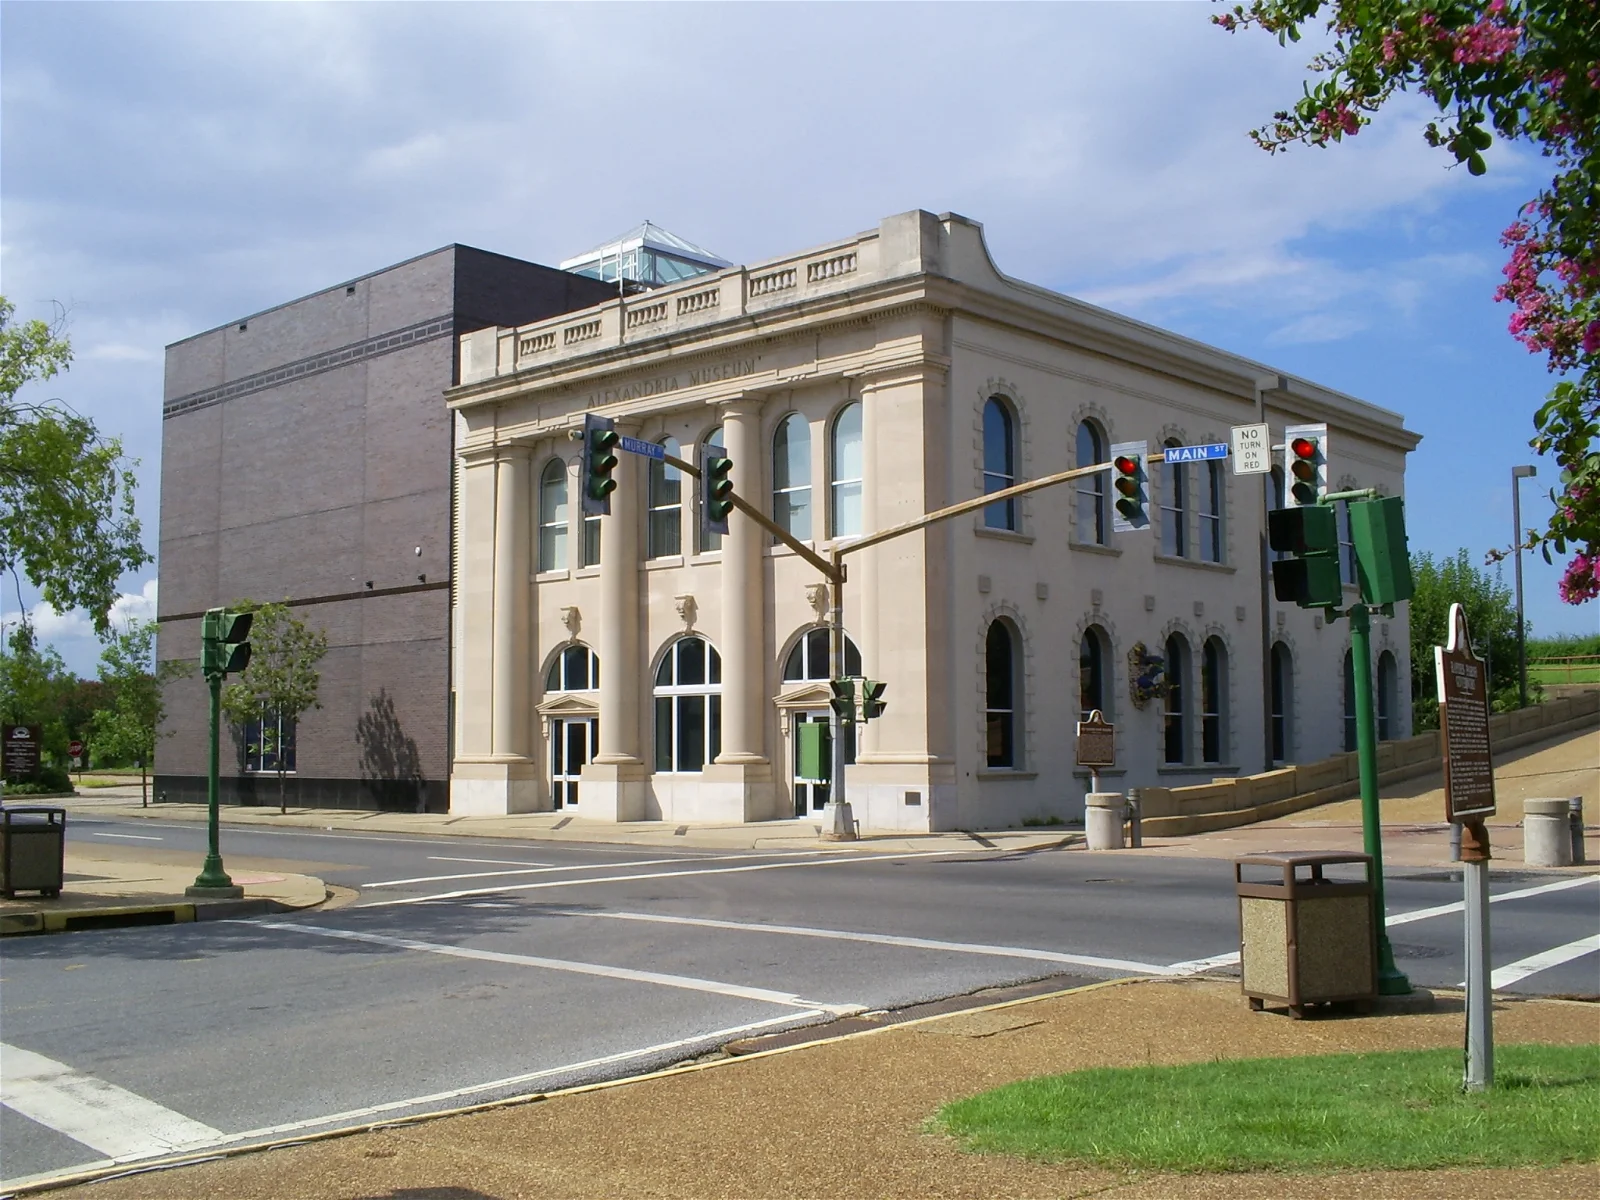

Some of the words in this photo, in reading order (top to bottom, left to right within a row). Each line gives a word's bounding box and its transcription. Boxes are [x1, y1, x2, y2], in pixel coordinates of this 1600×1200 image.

[587, 376, 679, 409] ALEXANDRIA
[688, 359, 755, 387] MUSEUM
[1241, 430, 1258, 440] NO
[624, 438, 655, 456] MURRAY
[1240, 441, 1261, 449] TURN
[1169, 447, 1207, 461] MAIN
[1215, 445, 1225, 453] ST
[1245, 451, 1257, 459] ON
[1244, 461, 1260, 469] RED
